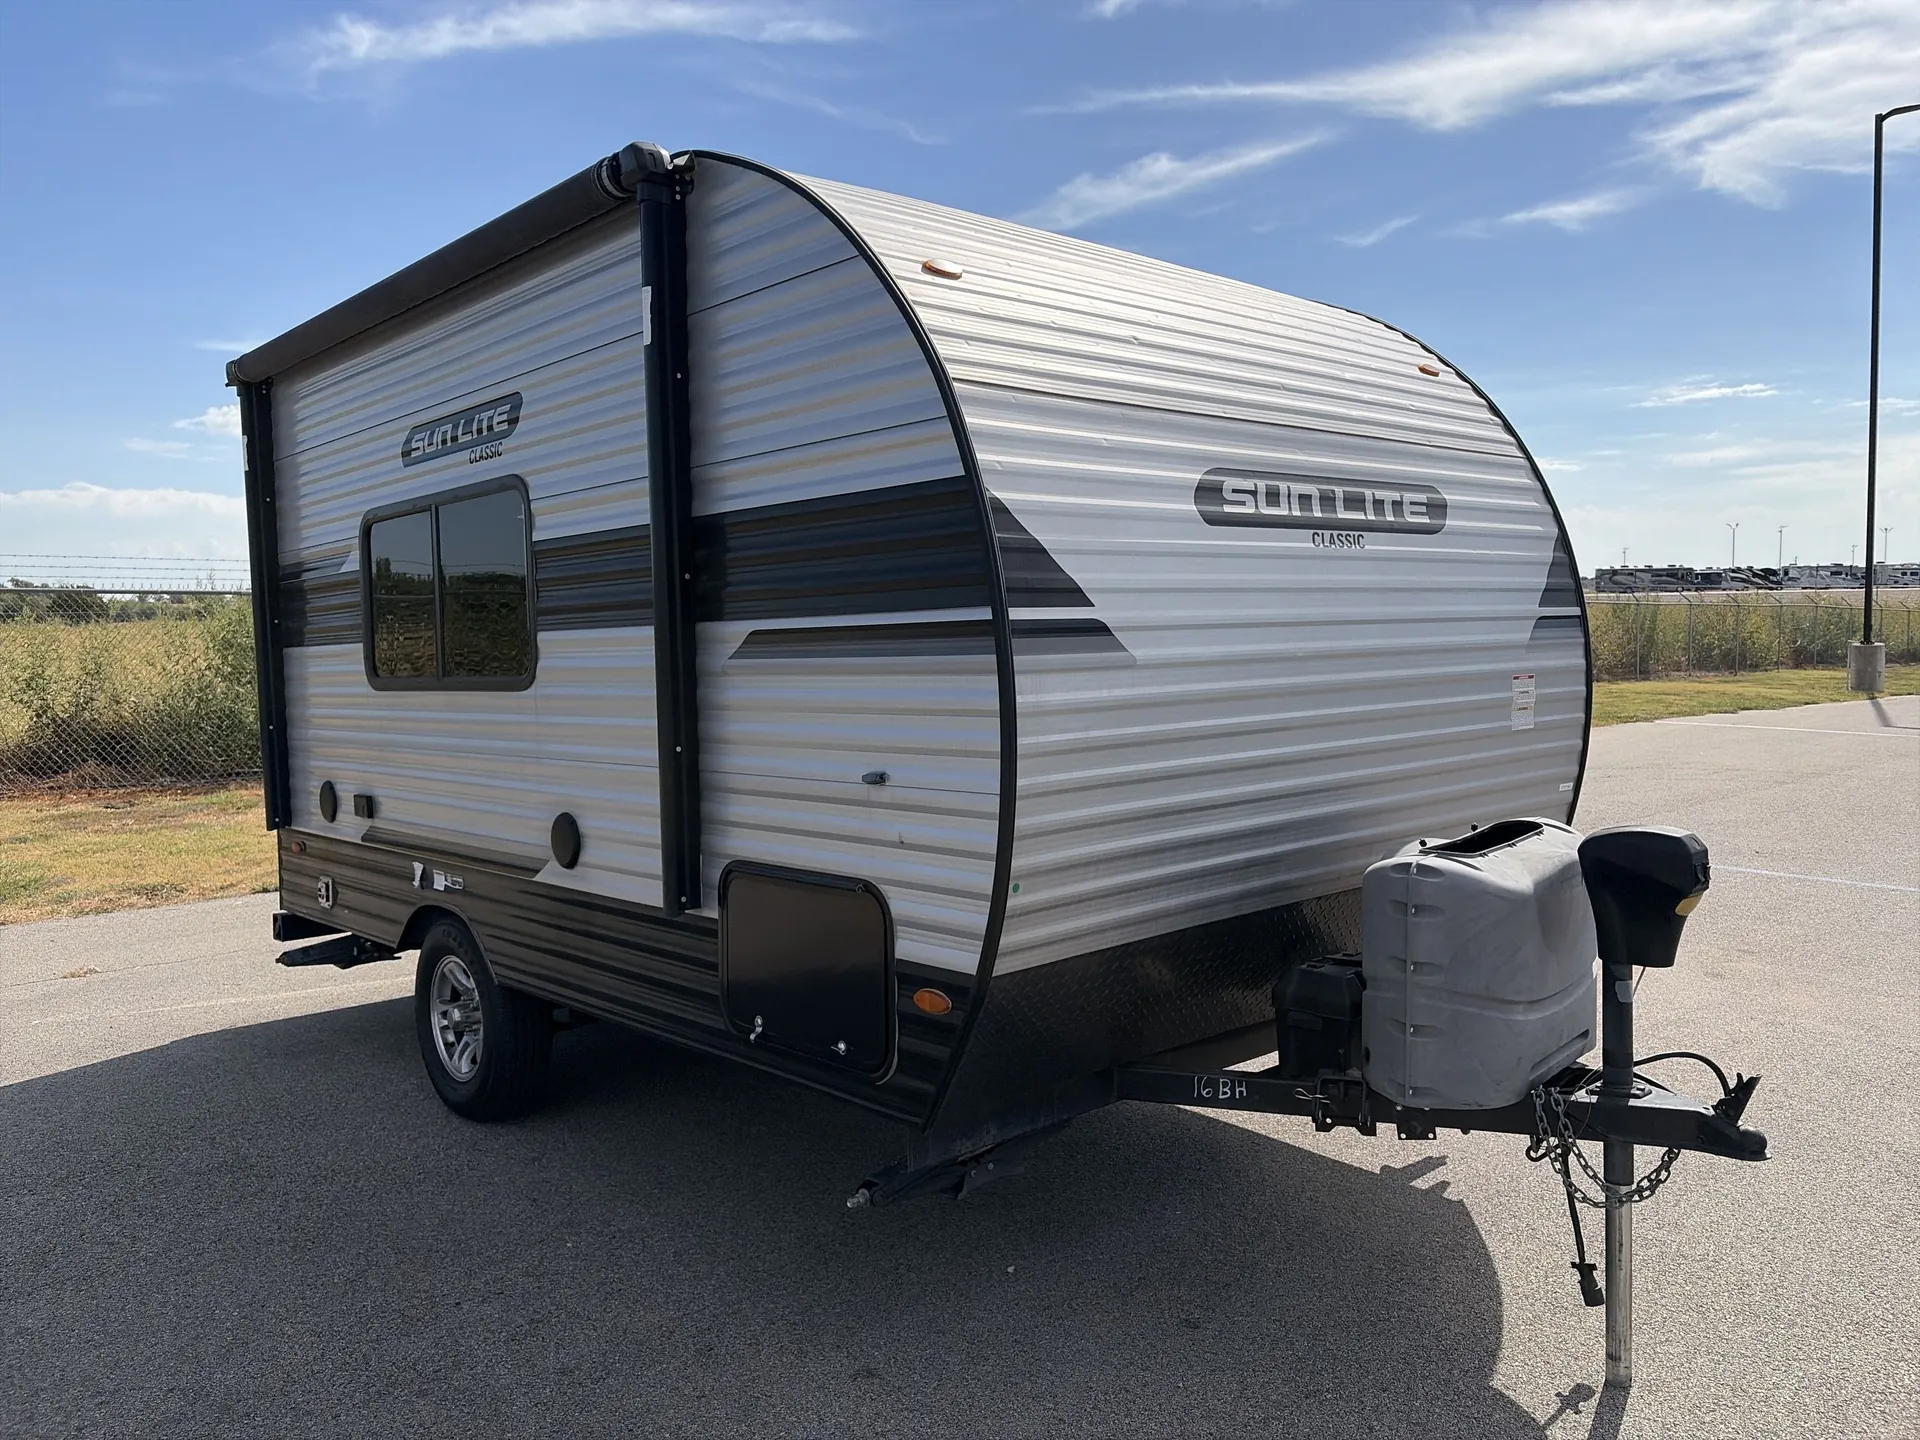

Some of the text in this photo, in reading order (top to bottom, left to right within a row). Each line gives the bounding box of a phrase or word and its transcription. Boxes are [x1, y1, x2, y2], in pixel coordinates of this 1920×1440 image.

[410, 404, 511, 458] SUN LITE
[468, 441, 504, 465] CLASSIC
[1221, 478, 1431, 524] SUN LITE
[1311, 531, 1366, 549] CLASSIC
